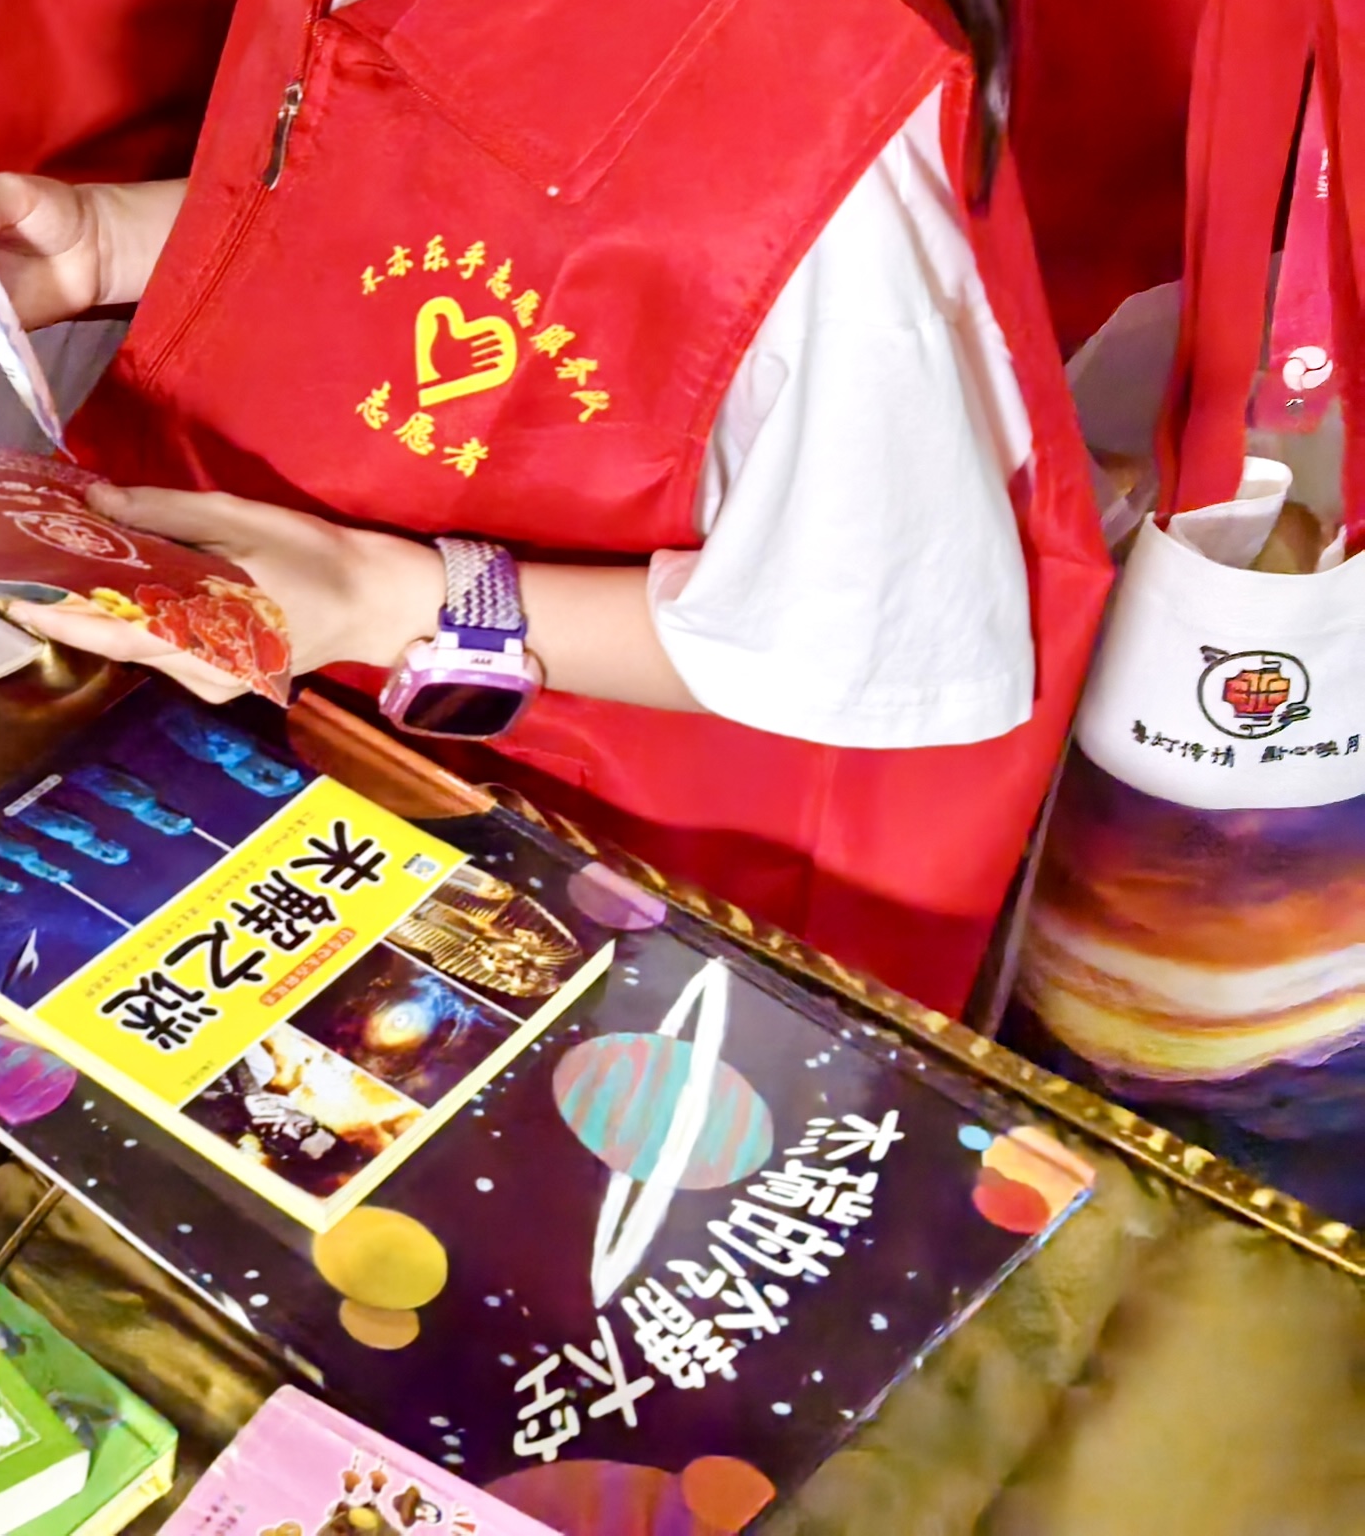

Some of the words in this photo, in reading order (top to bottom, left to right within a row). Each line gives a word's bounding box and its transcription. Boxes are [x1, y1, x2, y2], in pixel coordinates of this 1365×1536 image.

[355, 380, 489, 477] 志愿者
[101, 820, 387, 1050] 未解之谜
[514, 1109, 905, 1462] 杰瑞的冷静太空
